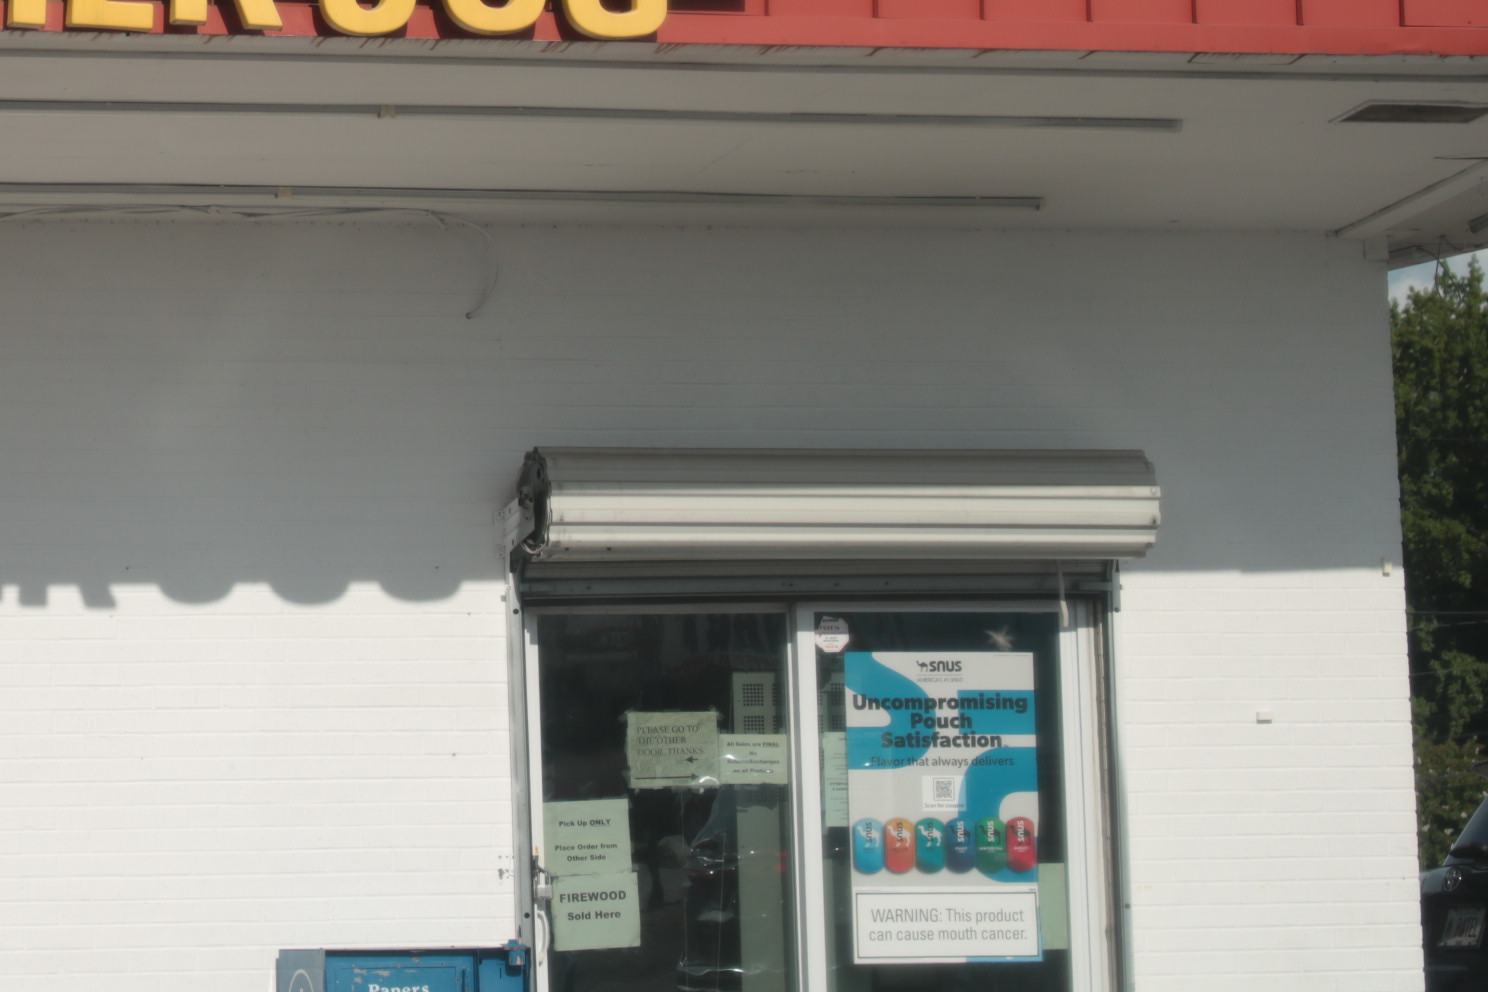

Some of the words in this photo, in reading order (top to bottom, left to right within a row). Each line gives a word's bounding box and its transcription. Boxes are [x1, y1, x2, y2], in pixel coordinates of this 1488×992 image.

[852, 693, 1028, 714] Uncompromising
[910, 712, 973, 729] Pouch
[636, 725, 670, 734] PLEASE
[672, 725, 685, 734] GO
[687, 724, 699, 733] TO
[637, 737, 654, 745] THE
[656, 736, 687, 745] OTHER
[881, 731, 1002, 748] Satisfaction
[667, 746, 704, 756] THANKS
[870, 756, 905, 767] Flavor
[907, 756, 929, 767] that
[933, 756, 969, 768] always
[971, 756, 1015, 767] delivers
[589, 818, 611, 826] ONLY
[577, 843, 598, 851] Order
[559, 890, 627, 903] FIREWOOD
[567, 911, 591, 921] Sold
[595, 910, 621, 920] Here
[870, 908, 943, 923] WARNING:
[945, 907, 972, 922] This
[975, 908, 1025, 925] product
[869, 930, 893, 941] can
[896, 929, 935, 941] cause
[938, 927, 978, 940] mouth
[981, 928, 1028, 940] cancer.
